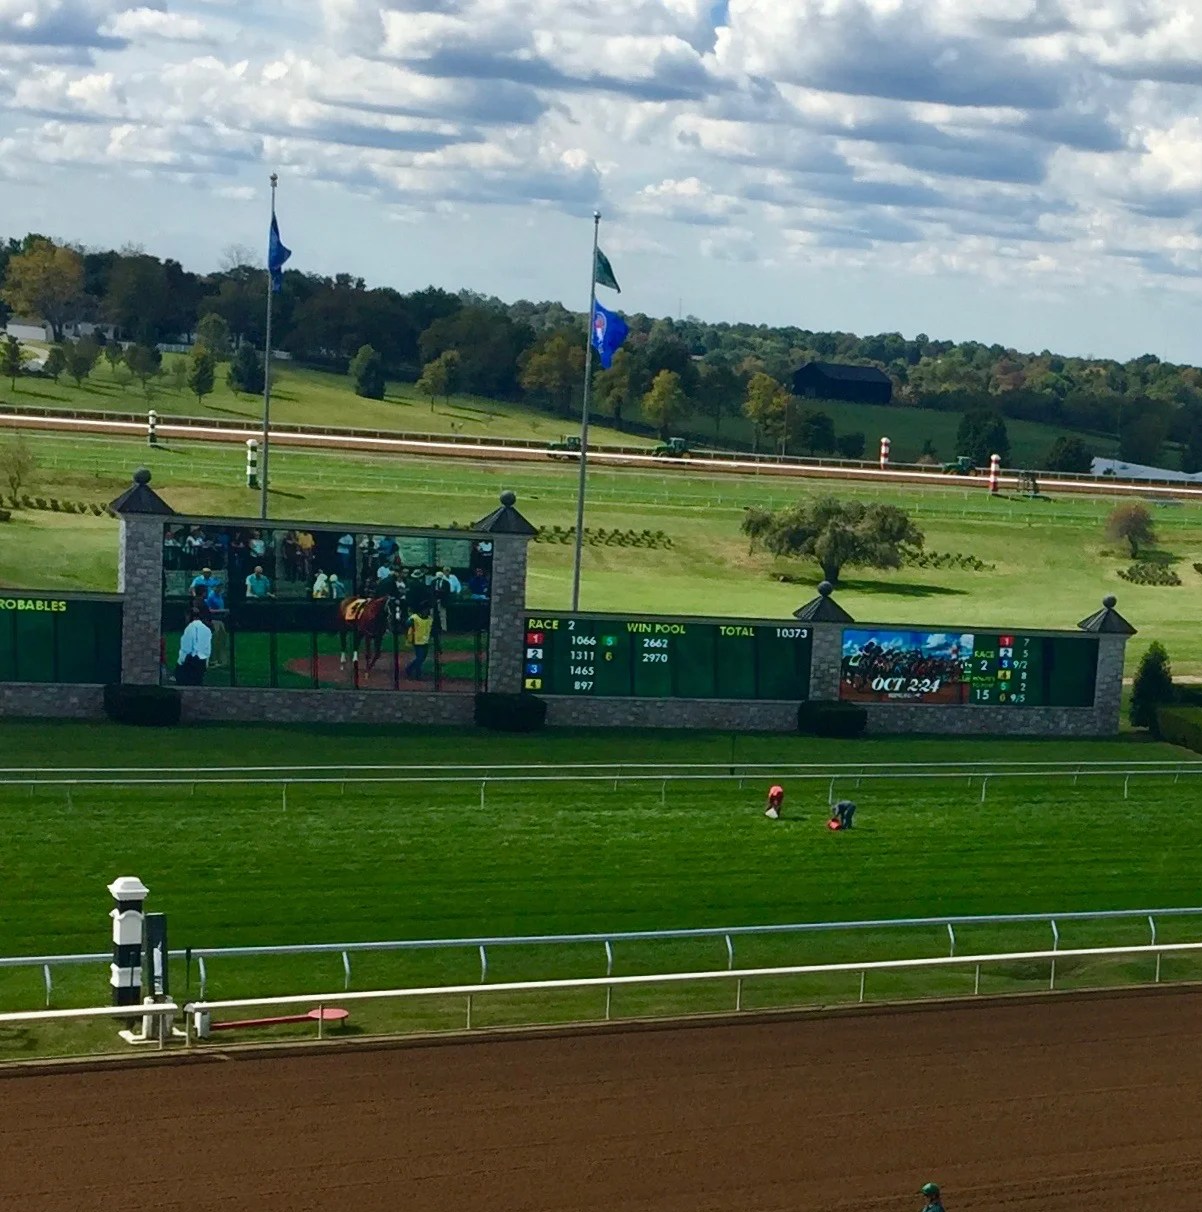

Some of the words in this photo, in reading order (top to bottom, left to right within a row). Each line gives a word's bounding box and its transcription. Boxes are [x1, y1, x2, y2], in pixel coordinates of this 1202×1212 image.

[528, 619, 559, 630] RACE
[568, 620, 575, 630] 2
[627, 623, 652, 633] WIN
[655, 624, 686, 634] POOL
[720, 626, 755, 637] TOTAL
[776, 628, 808, 639] 10373
[571, 635, 597, 646] 1066
[606, 637, 613, 646] 5
[643, 639, 668, 648] 2662
[1024, 638, 1030, 646] 7
[570, 651, 595, 661] 1311
[642, 653, 668, 662] 2970
[1023, 650, 1029, 658] 5
[981, 660, 988, 670] 2
[1013, 661, 1028, 669] 9/2
[570, 666, 594, 676] 1465
[574, 681, 594, 690] 897
[871, 677, 907, 692] OCT
[1020, 683, 1026, 691] 2
[976, 689, 989, 700] 15
